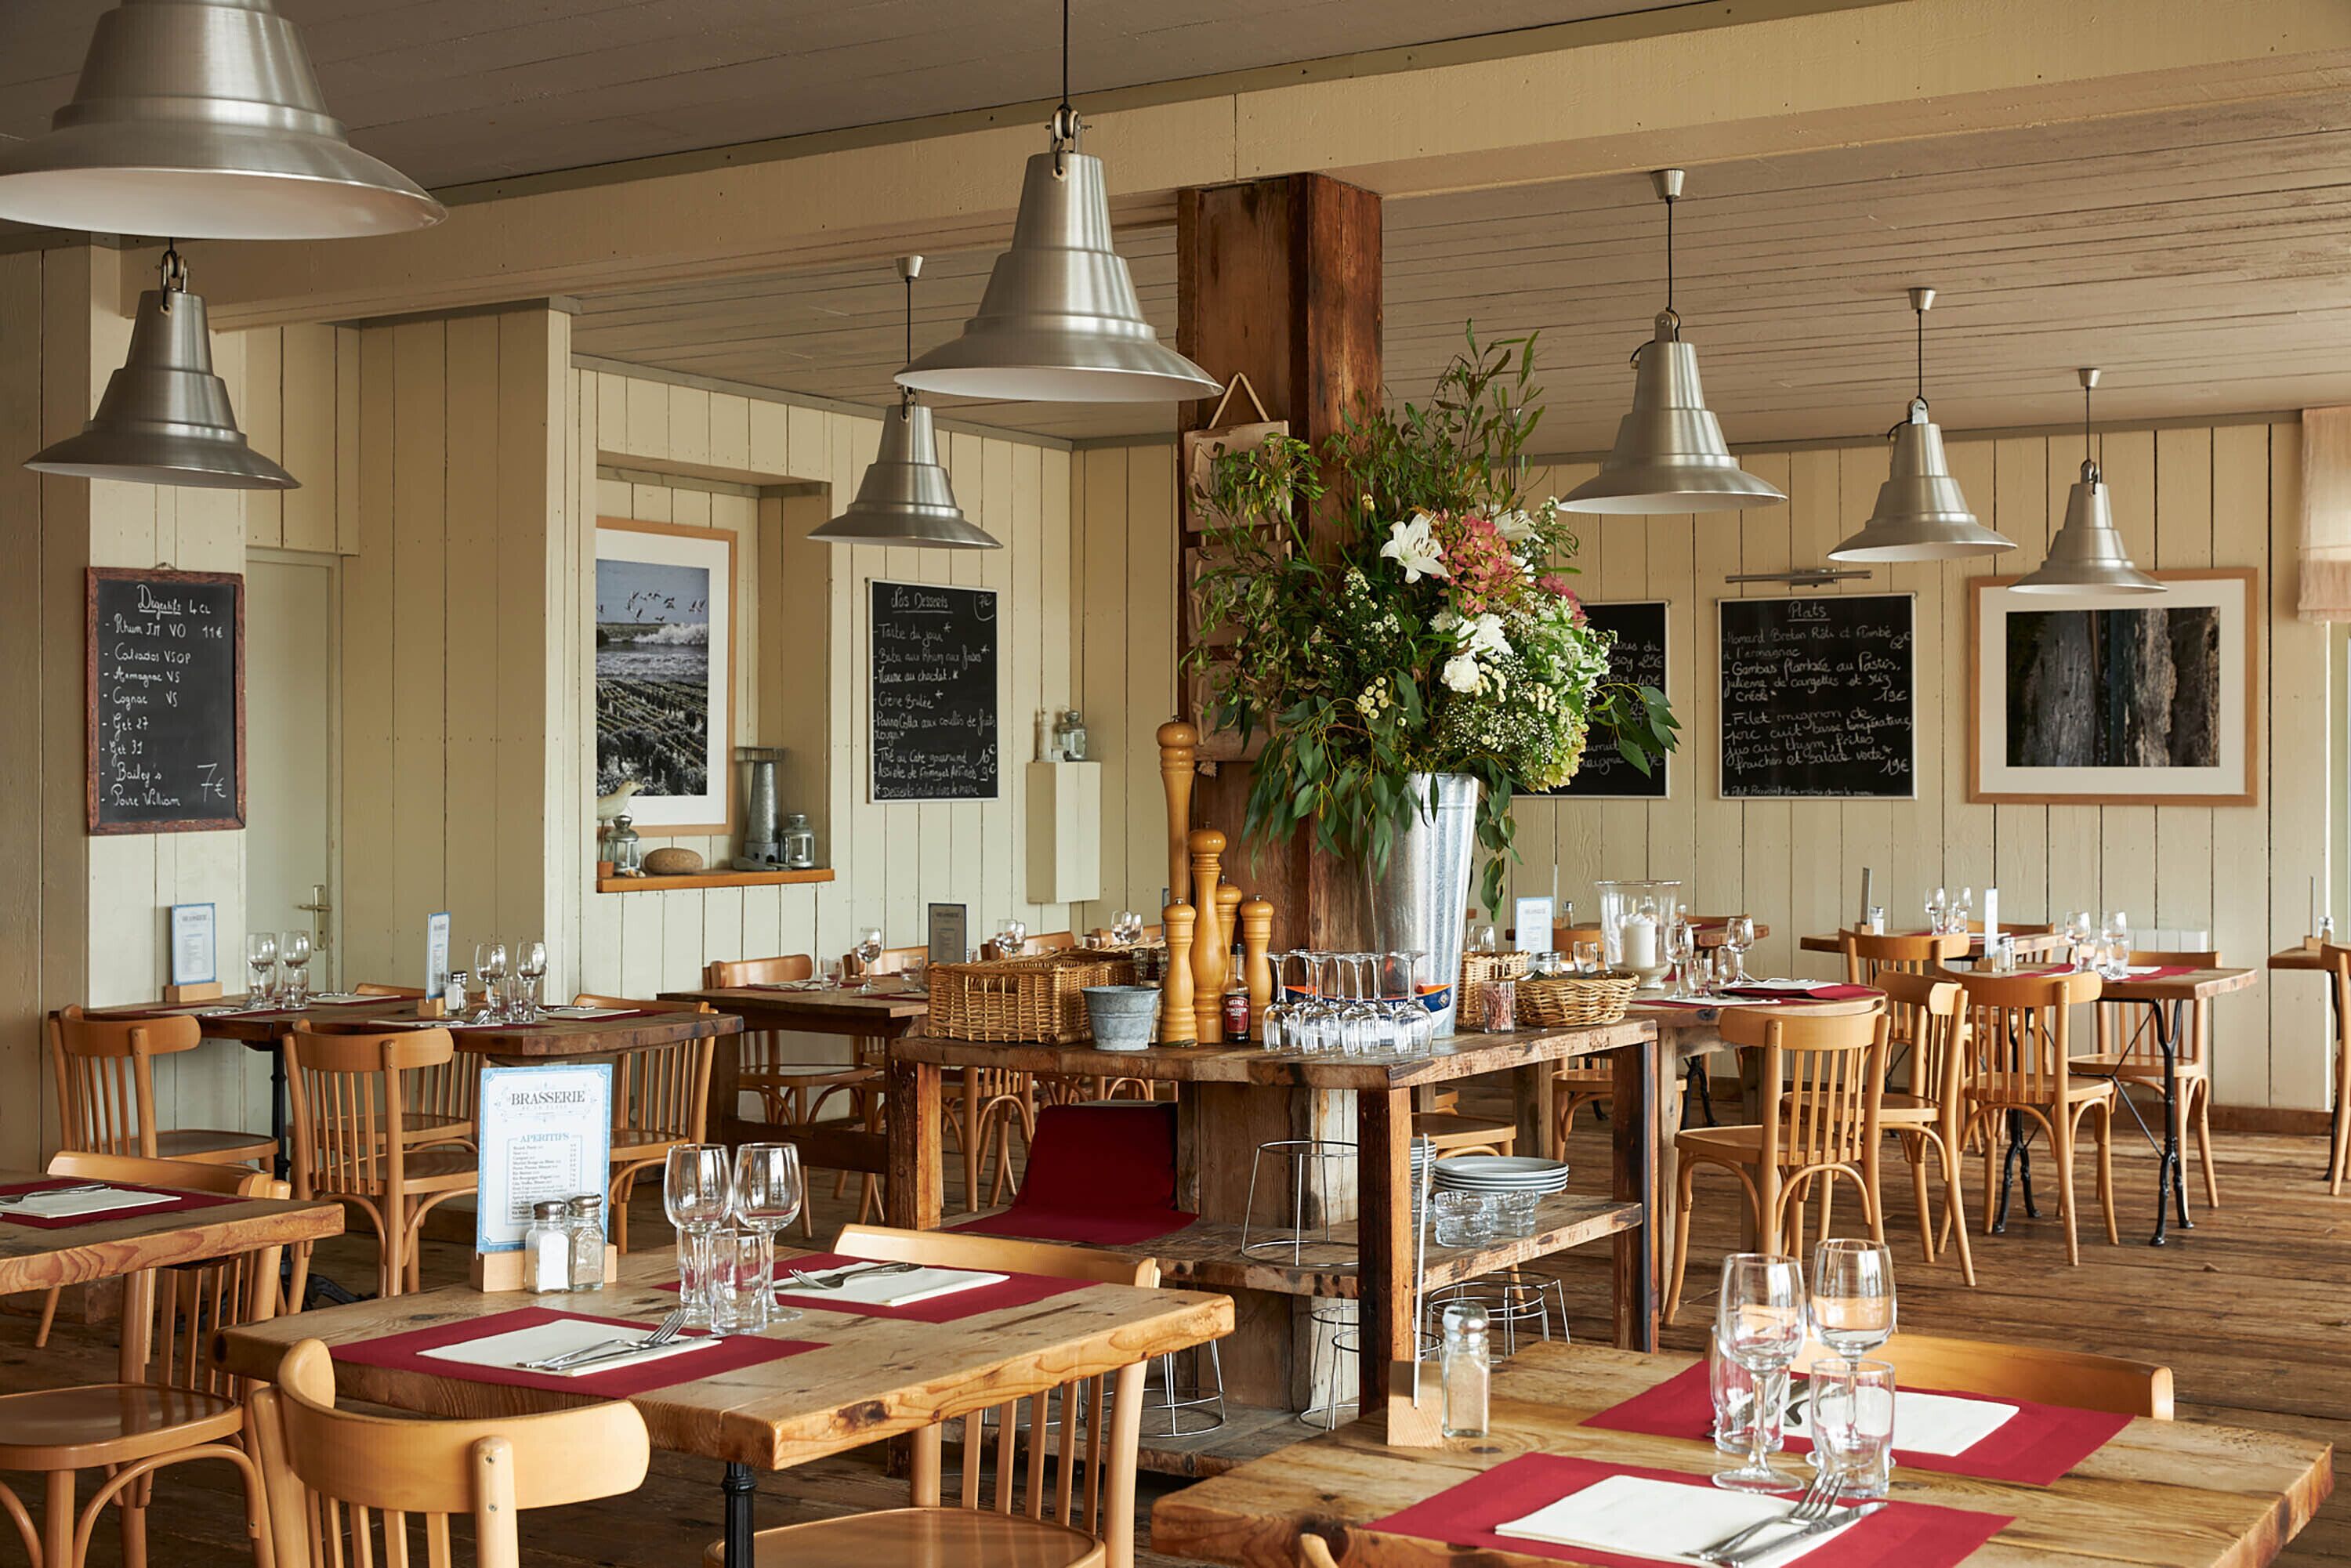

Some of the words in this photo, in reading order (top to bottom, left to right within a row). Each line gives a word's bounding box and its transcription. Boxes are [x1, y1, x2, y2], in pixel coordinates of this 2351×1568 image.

[915, 592, 948, 610] Desserts
[1788, 600, 1827, 619] Plats
[114, 613, 143, 634] Rhum
[169, 623, 187, 638] VO
[877, 622, 906, 640] Tarte
[910, 623, 922, 640] du
[923, 632, 944, 647] jour
[1770, 628, 1806, 642] Breton
[114, 641, 160, 662] Calvados
[164, 650, 191, 664] VSOP
[878, 646, 901, 664] Baba
[114, 665, 162, 688] Armagnac
[166, 671, 180, 683] VS
[904, 672, 915, 683] au
[1732, 661, 1777, 677] Gambas
[1836, 663, 1853, 673] au
[1773, 677, 1787, 688] de
[113, 686, 148, 711] Cognac
[166, 690, 178, 708] VS
[1873, 690, 1907, 702] 19€
[114, 712, 132, 741] Get
[136, 715, 149, 730] 27
[966, 714, 976, 728] de
[1731, 710, 1772, 726] Filet
[1777, 709, 1842, 730] mignon
[1849, 707, 1871, 720] de
[1769, 722, 1803, 739] cuit
[132, 739, 143, 755] 31
[877, 746, 895, 763] Thé
[1724, 741, 1749, 767] jus
[1751, 744, 1779, 754] au
[907, 763, 918, 780] de
[1786, 750, 1804, 766] et
[1808, 749, 1852, 765] salade
[1879, 758, 1910, 776] 19€
[110, 783, 139, 807] Poire
[511, 1090, 585, 1106] BRASSERIE
